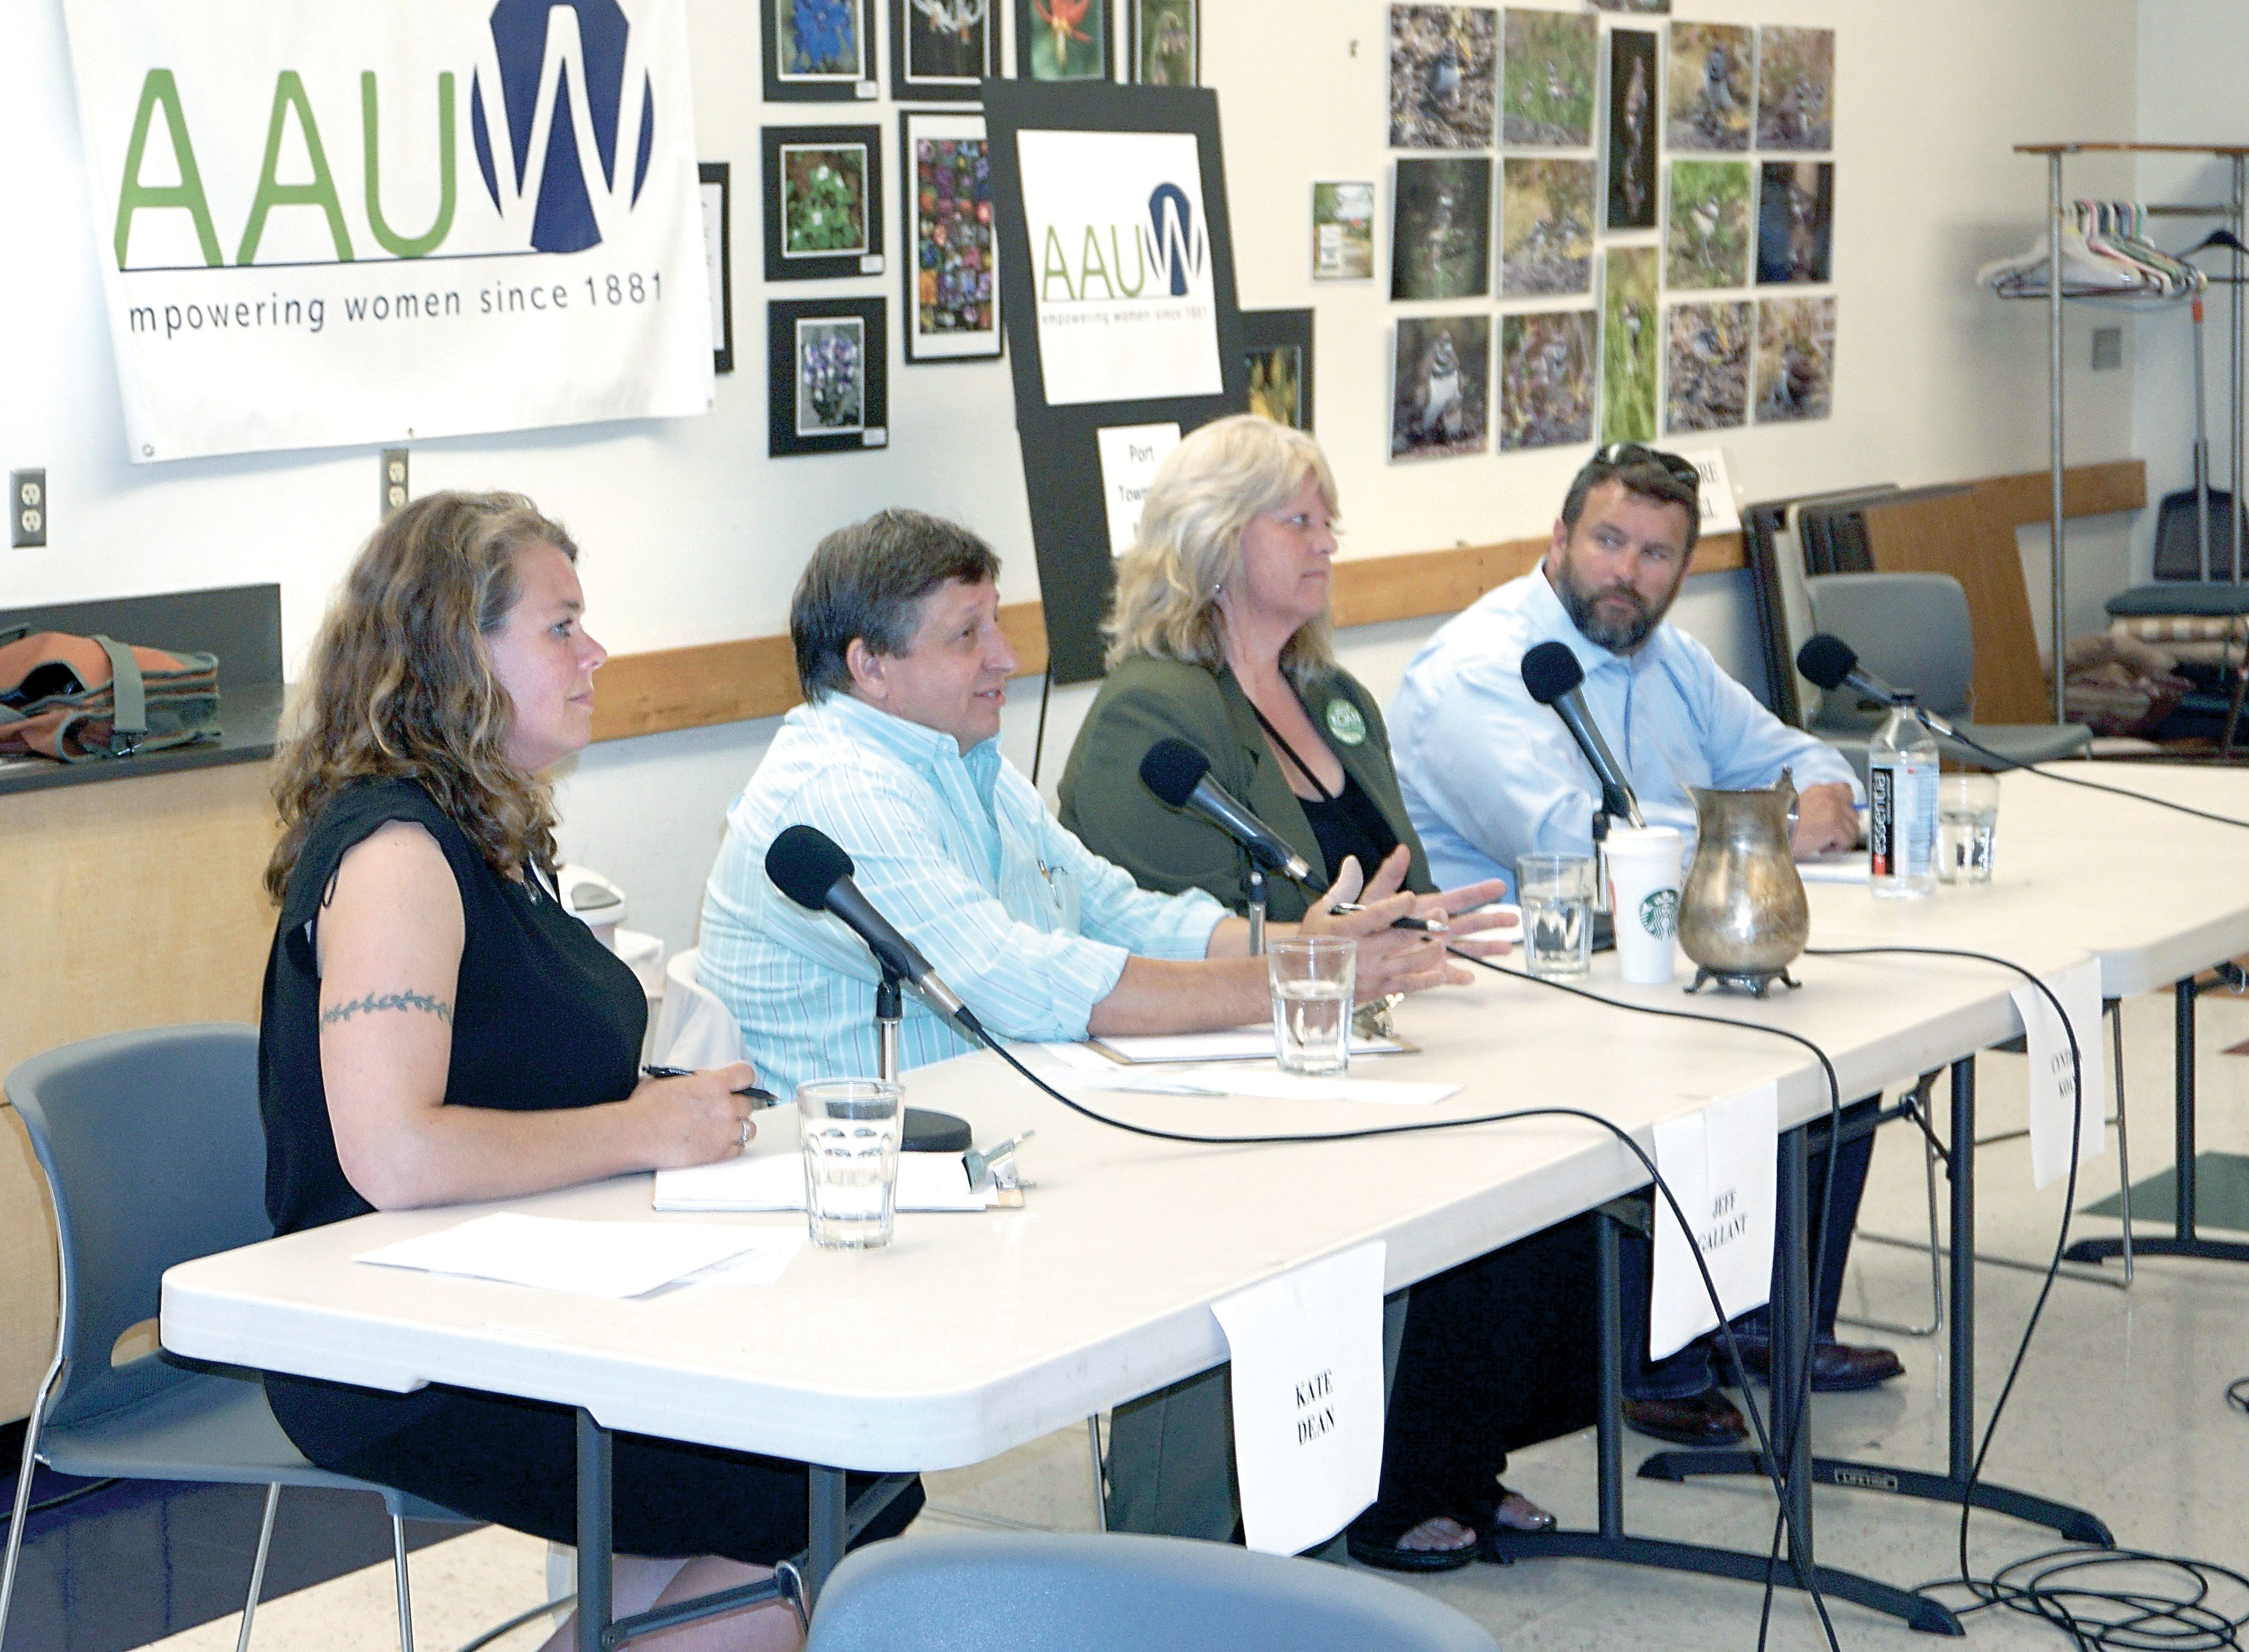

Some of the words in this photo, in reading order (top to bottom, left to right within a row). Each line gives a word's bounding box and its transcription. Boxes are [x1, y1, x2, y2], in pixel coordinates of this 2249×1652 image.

[114, 0, 653, 271] AAUW
[1042, 182, 1203, 301] AAUW
[129, 291, 325, 340] mpowering
[344, 290, 461, 322] women
[480, 280, 568, 314] since
[584, 271, 662, 306] 1881
[1129, 444, 1155, 464] Port
[1712, 1187, 1736, 1220] JEFF
[1697, 1211, 1747, 1254] GALLANT
[1295, 1368, 1333, 1410] KATE
[1297, 1404, 1335, 1447] DEAN
